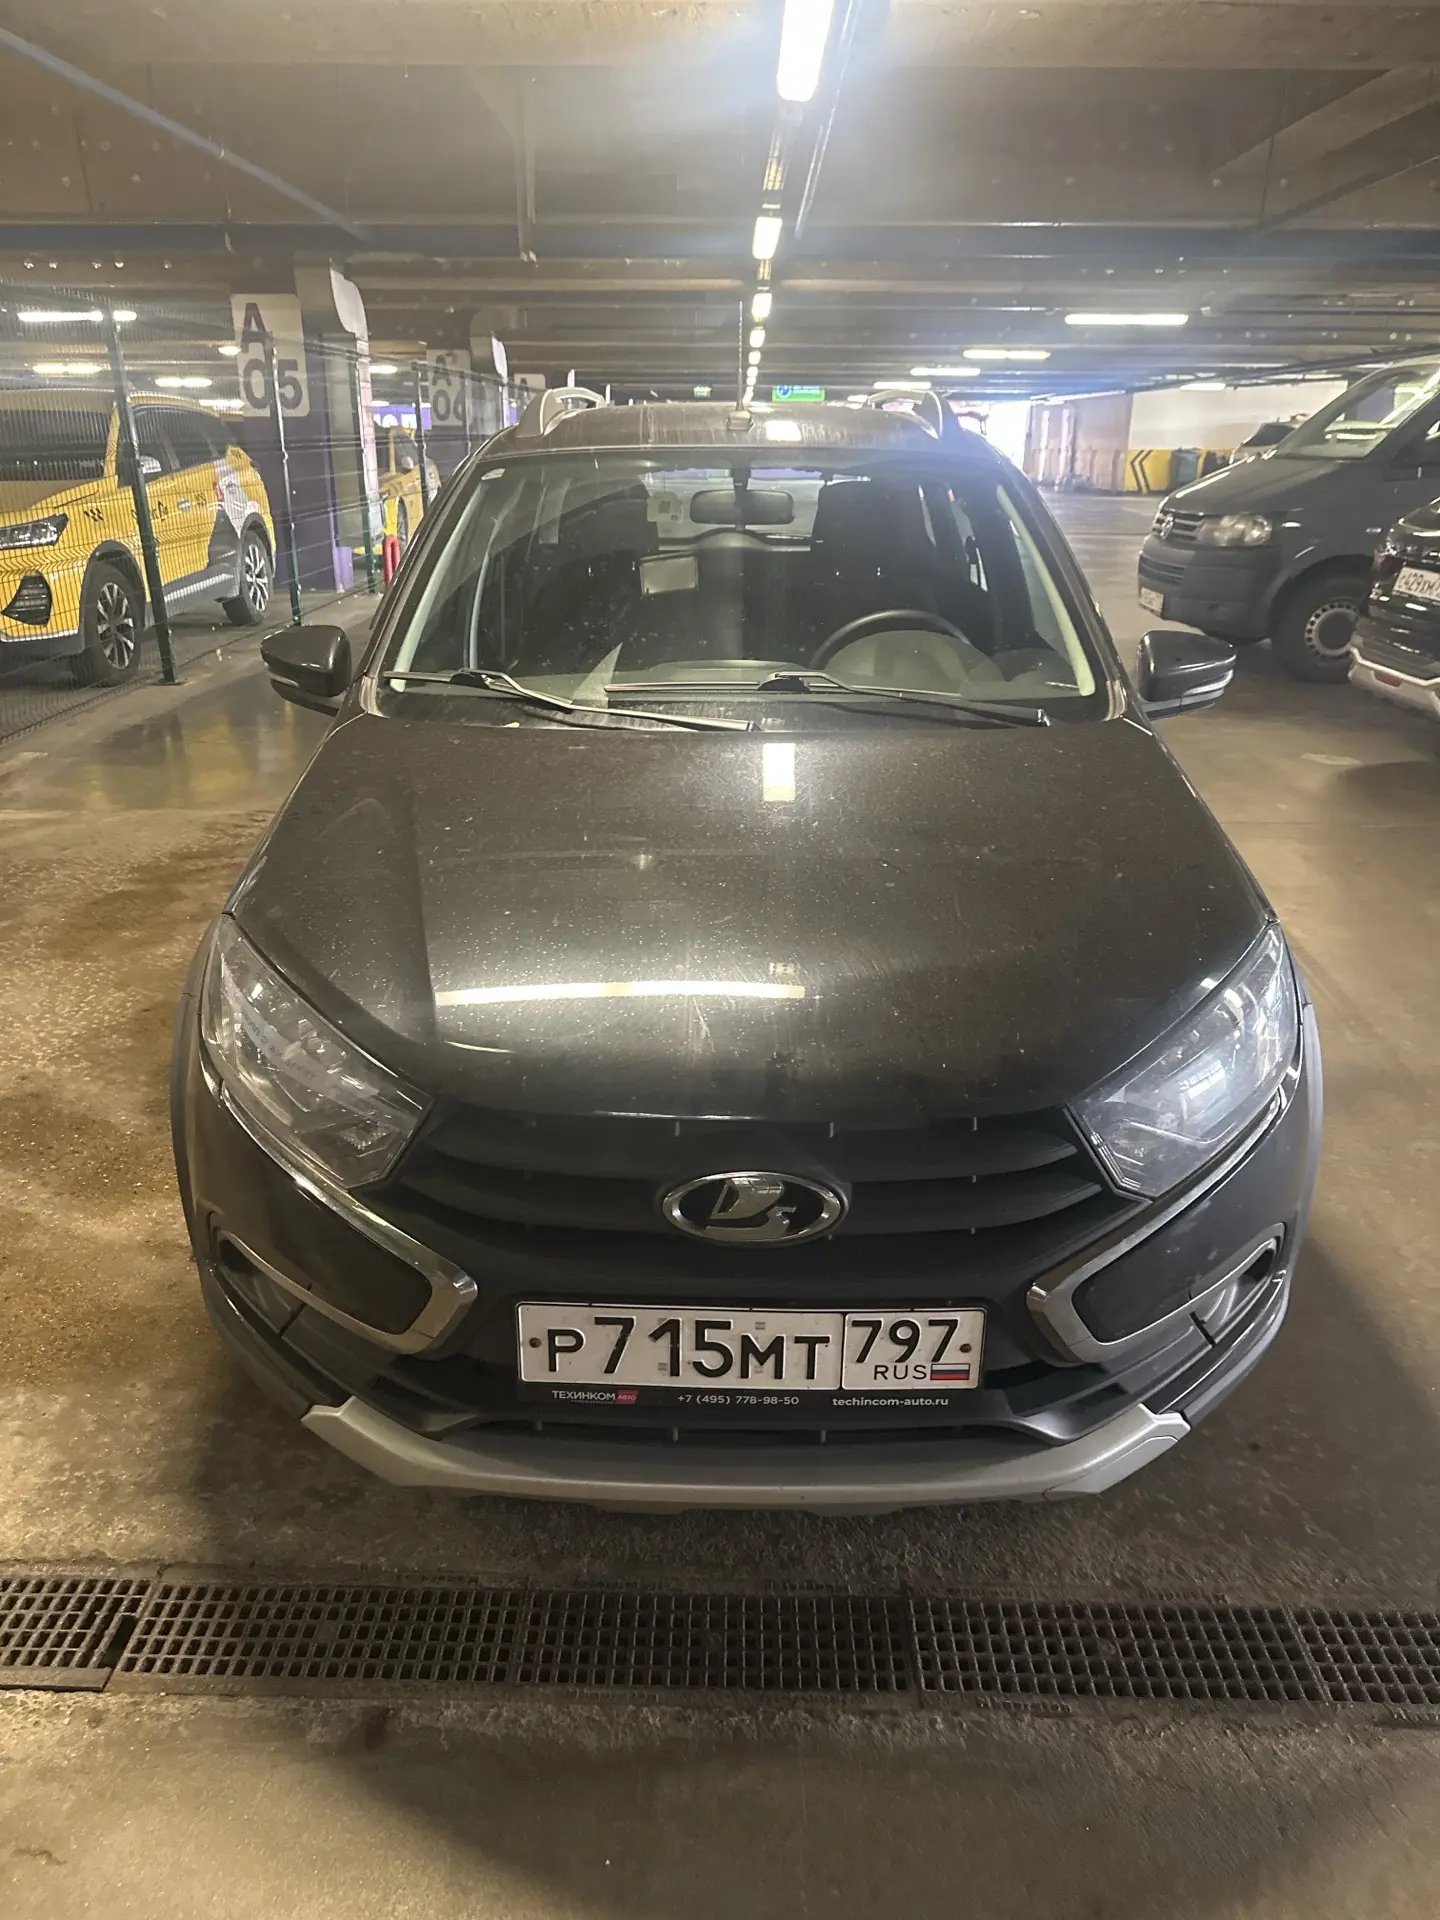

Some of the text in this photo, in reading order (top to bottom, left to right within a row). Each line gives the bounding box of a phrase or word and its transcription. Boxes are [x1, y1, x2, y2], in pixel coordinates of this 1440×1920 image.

[241, 302, 272, 353] A
[243, 358, 303, 410] 05
[851, 1318, 960, 1364] 797
[873, 1364, 928, 1381] RUS
[551, 1390, 616, 1401] ТЕХИНКОМ
[677, 1394, 800, 1405] +7 (495) 778-98-50
[832, 1396, 949, 1406] techincom-auto.ru
